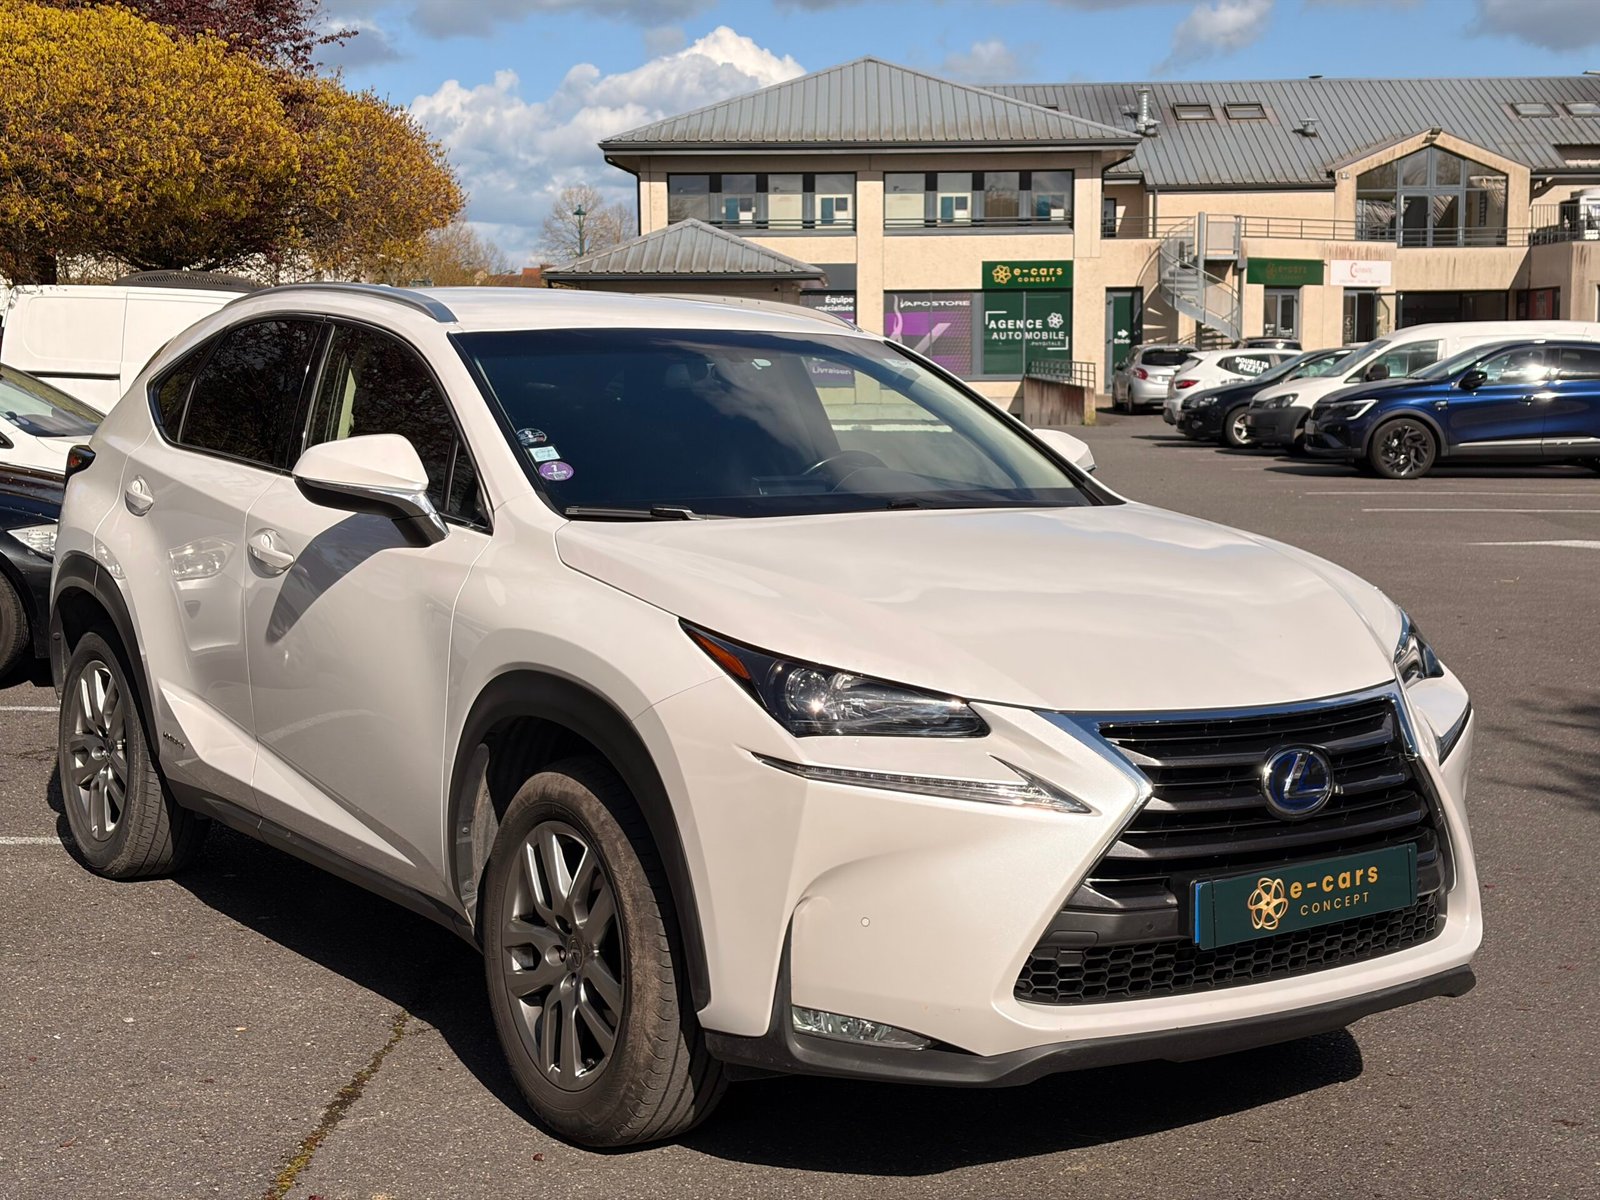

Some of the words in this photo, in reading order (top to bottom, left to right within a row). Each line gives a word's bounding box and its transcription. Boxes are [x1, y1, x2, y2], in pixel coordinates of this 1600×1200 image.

[1013, 267, 1063, 276] e-cars
[825, 295, 854, 304] Équipe
[988, 319, 1043, 329] AGENCE
[991, 331, 1065, 340] AUTOMOBILE
[1289, 865, 1379, 899] e-cars
[1300, 892, 1370, 916] CONCEPT
